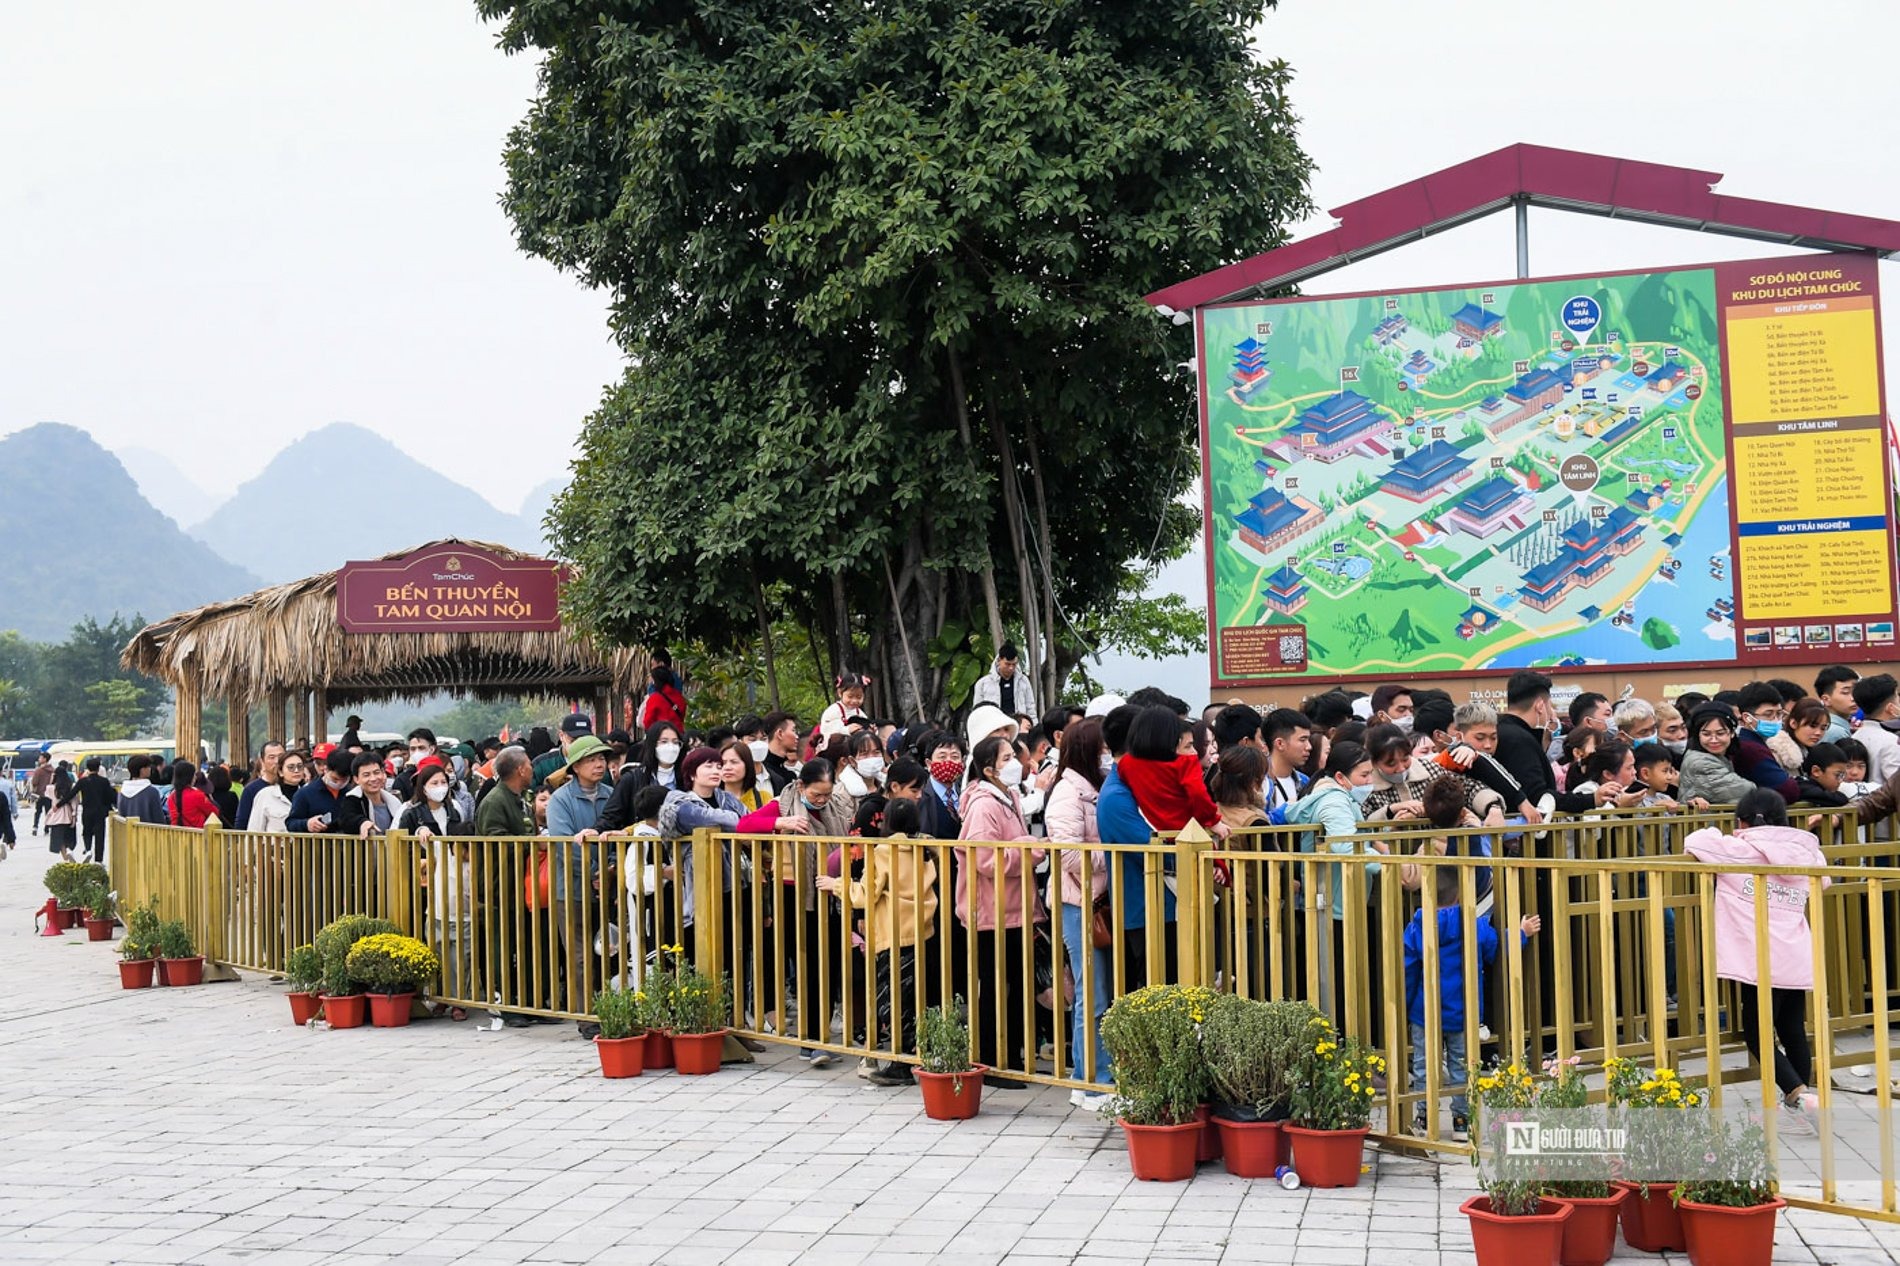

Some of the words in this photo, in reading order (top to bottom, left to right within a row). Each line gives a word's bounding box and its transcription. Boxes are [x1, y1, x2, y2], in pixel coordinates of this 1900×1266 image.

[1750, 275, 1766, 286] SƠ
[1786, 271, 1808, 284] NỘI
[1809, 269, 1842, 280] CUNG
[1732, 290, 1757, 301] KHU
[1758, 289, 1776, 300] DU
[1777, 286, 1802, 299] LỊCH
[1803, 284, 1828, 295] TAM
[1829, 280, 1862, 294] CHÚC
[1778, 423, 1796, 432] KHU
[1798, 422, 1816, 430] TÂM
[1817, 420, 1838, 429] LINH
[1594, 508, 1602, 516] 10
[1778, 524, 1796, 532] KHU
[1796, 522, 1816, 531] TRẢI
[1816, 520, 1850, 532] NGHIỆM
[386, 582, 429, 600] BẾN
[433, 581, 520, 601] THUYỀN
[374, 604, 420, 618] TAM
[425, 604, 488, 620] QUAN
[493, 600, 532, 620] NỘI
